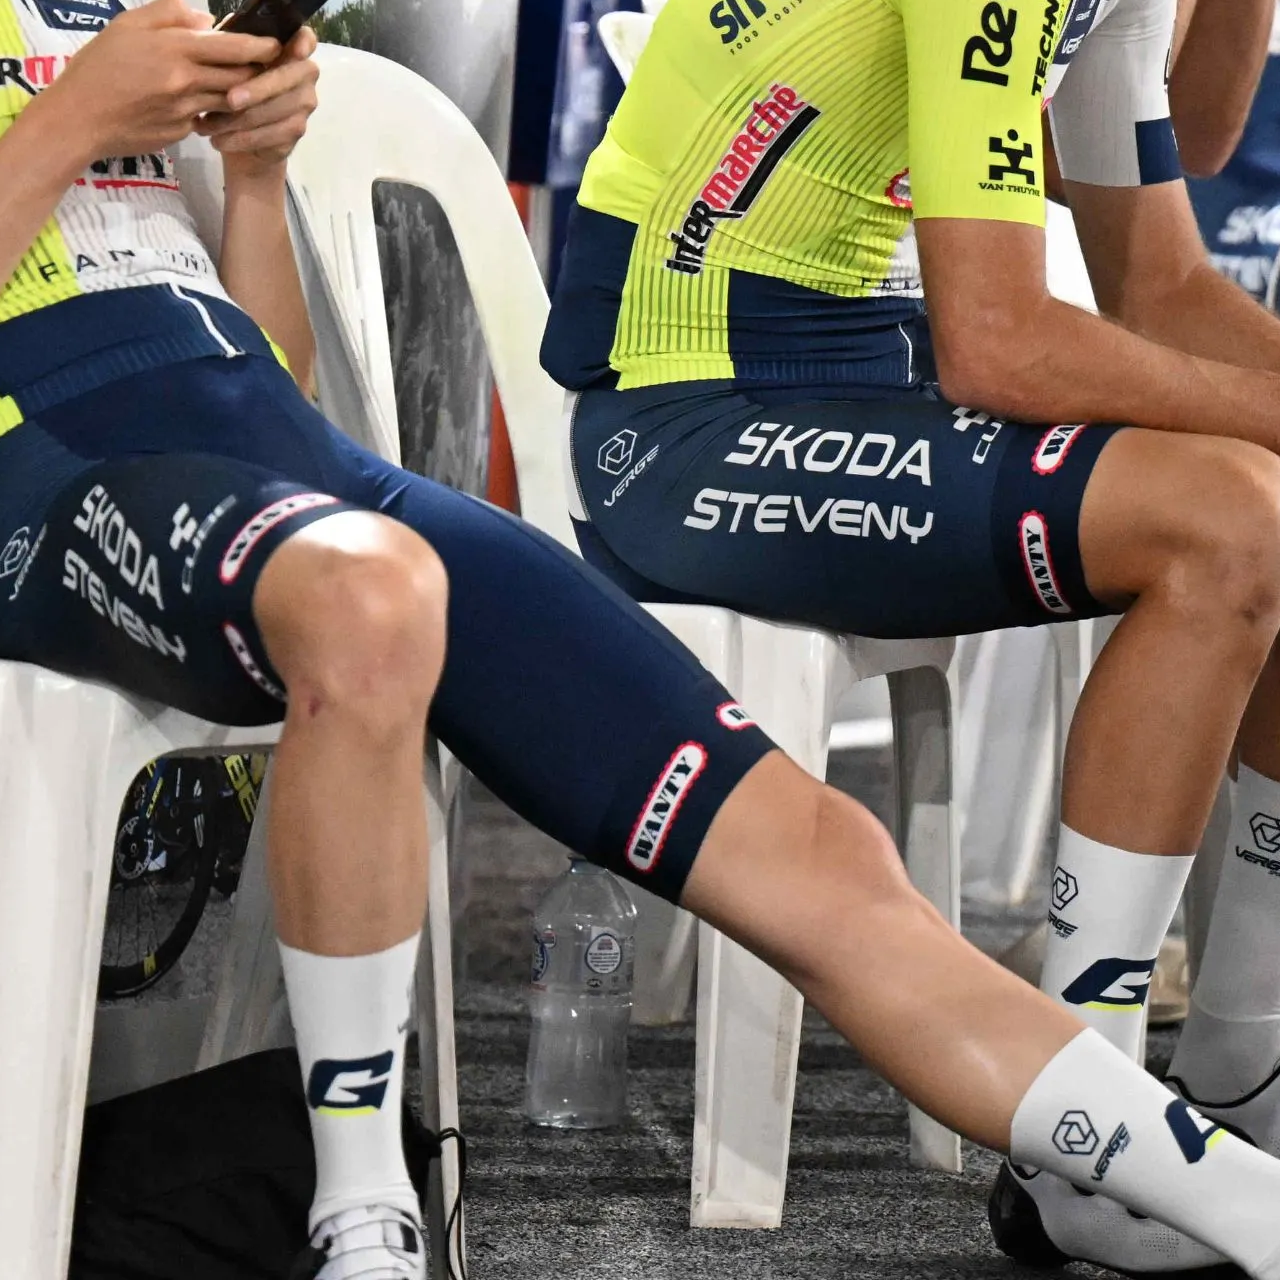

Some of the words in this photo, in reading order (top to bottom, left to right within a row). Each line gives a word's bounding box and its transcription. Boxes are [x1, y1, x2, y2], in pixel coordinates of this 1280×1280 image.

[52, 8, 111, 26] VER
[729, 30, 760, 57] FOOD
[978, 181, 1004, 192] VAN
[1005, 184, 1041, 197] THUYNE
[723, 421, 933, 487] SKODA
[971, 420, 1007, 465] CU
[682, 487, 935, 545] STEVENY
[72, 483, 165, 612] SKODA
[1026, 527, 1064, 610] WANTY
[62, 547, 187, 664] STEVENY
[632, 755, 694, 861] WANTY
[1047, 909, 1079, 936] RGE
[1090, 1121, 1130, 1182] VERGE
